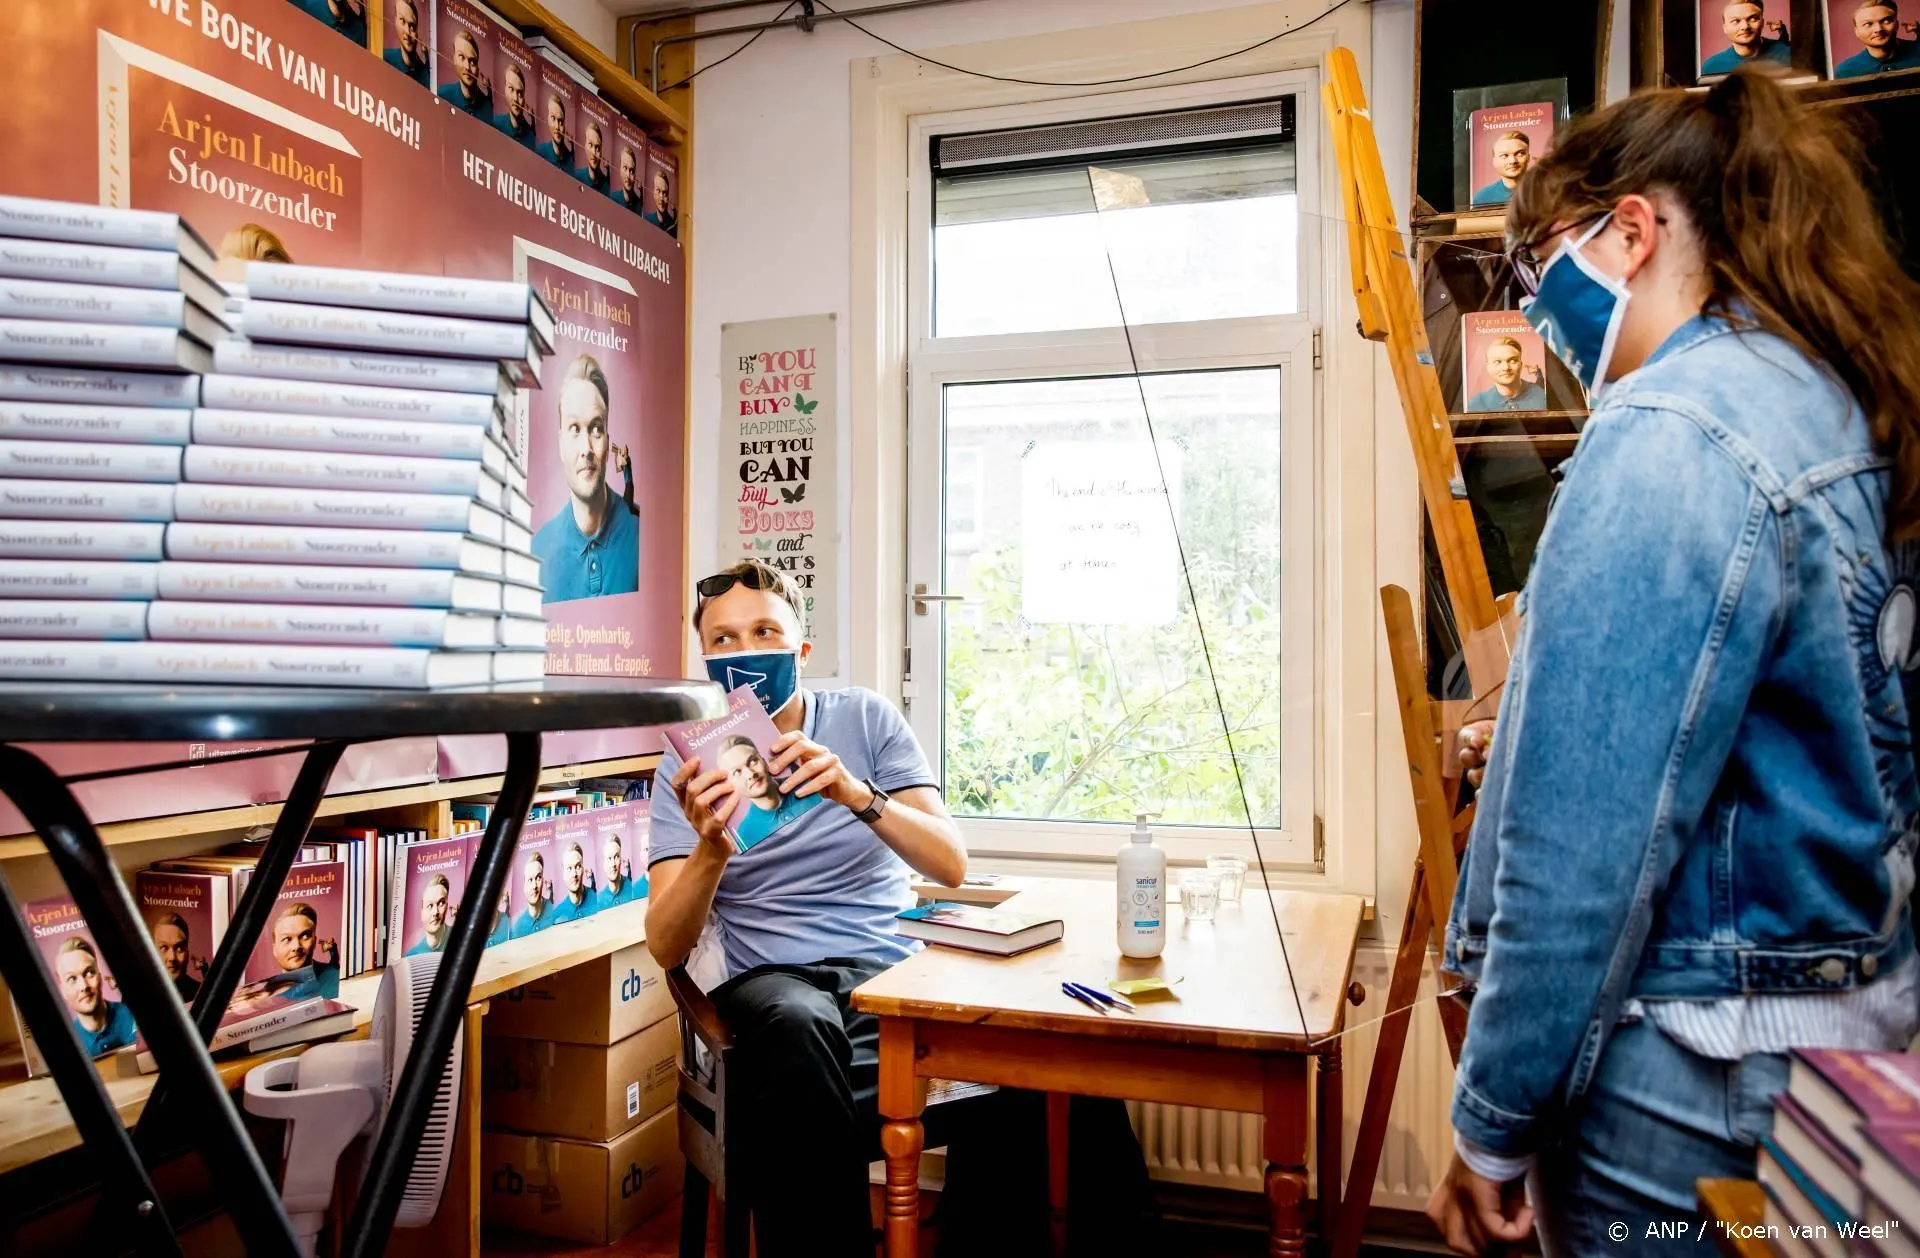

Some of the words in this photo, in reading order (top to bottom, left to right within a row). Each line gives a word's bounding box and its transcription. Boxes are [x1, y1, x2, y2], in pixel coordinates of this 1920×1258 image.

[446, 6, 487, 38] Stoorzender
[499, 43, 532, 70] Stoorzender
[149, 0, 193, 27] E
[201, 0, 273, 71] BOEK
[278, 44, 326, 99] VAN
[333, 75, 421, 150] LUBACH!
[542, 73, 571, 99] Stoorzender
[1481, 113, 1508, 122] Arjen
[1509, 108, 1544, 119] Lubach
[1482, 118, 1541, 130] Stoorzender
[157, 101, 246, 162] Arjen
[252, 133, 344, 197] Lubach
[168, 147, 337, 233] Stoorzender
[463, 150, 494, 190] HET
[497, 169, 557, 223] NIEUWE
[560, 203, 595, 244] BOEK
[597, 224, 620, 258] VAN
[623, 240, 671, 284] LUBACH!
[542, 275, 581, 313] Arjen
[584, 289, 631, 327] Lubach
[1476, 325, 1532, 334] Stoorzender
[758, 347, 816, 373] YOU
[739, 372, 816, 396] CAN'T
[740, 396, 791, 416] BUY
[740, 440, 776, 455] BUT
[777, 438, 813, 453] YOU
[739, 456, 812, 483] CAN
[776, 533, 813, 552] and
[576, 624, 634, 649] Openhartig.
[576, 653, 612, 675] Bijtend.
[614, 653, 652, 677] Grappig.
[688, 709, 750, 750] Stoorzender
[555, 830, 589, 840] Stoorzender
[597, 821, 626, 832] Stoorzender
[416, 852, 438, 864] Arjen
[439, 847, 462, 860] Lubach
[520, 838, 551, 850] Stoorzender
[416, 858, 460, 874] Stoorzender
[168, 884, 202, 896] Lubach
[296, 872, 335, 886] Lubach
[143, 895, 200, 909] Stoorzender
[29, 909, 62, 925] Arjen
[62, 904, 80, 917] Lu
[621, 968, 641, 1002] cb
[227, 1014, 287, 1040] Stoorzender
[492, 1162, 524, 1196] cb
[621, 1163, 643, 1199] cb
